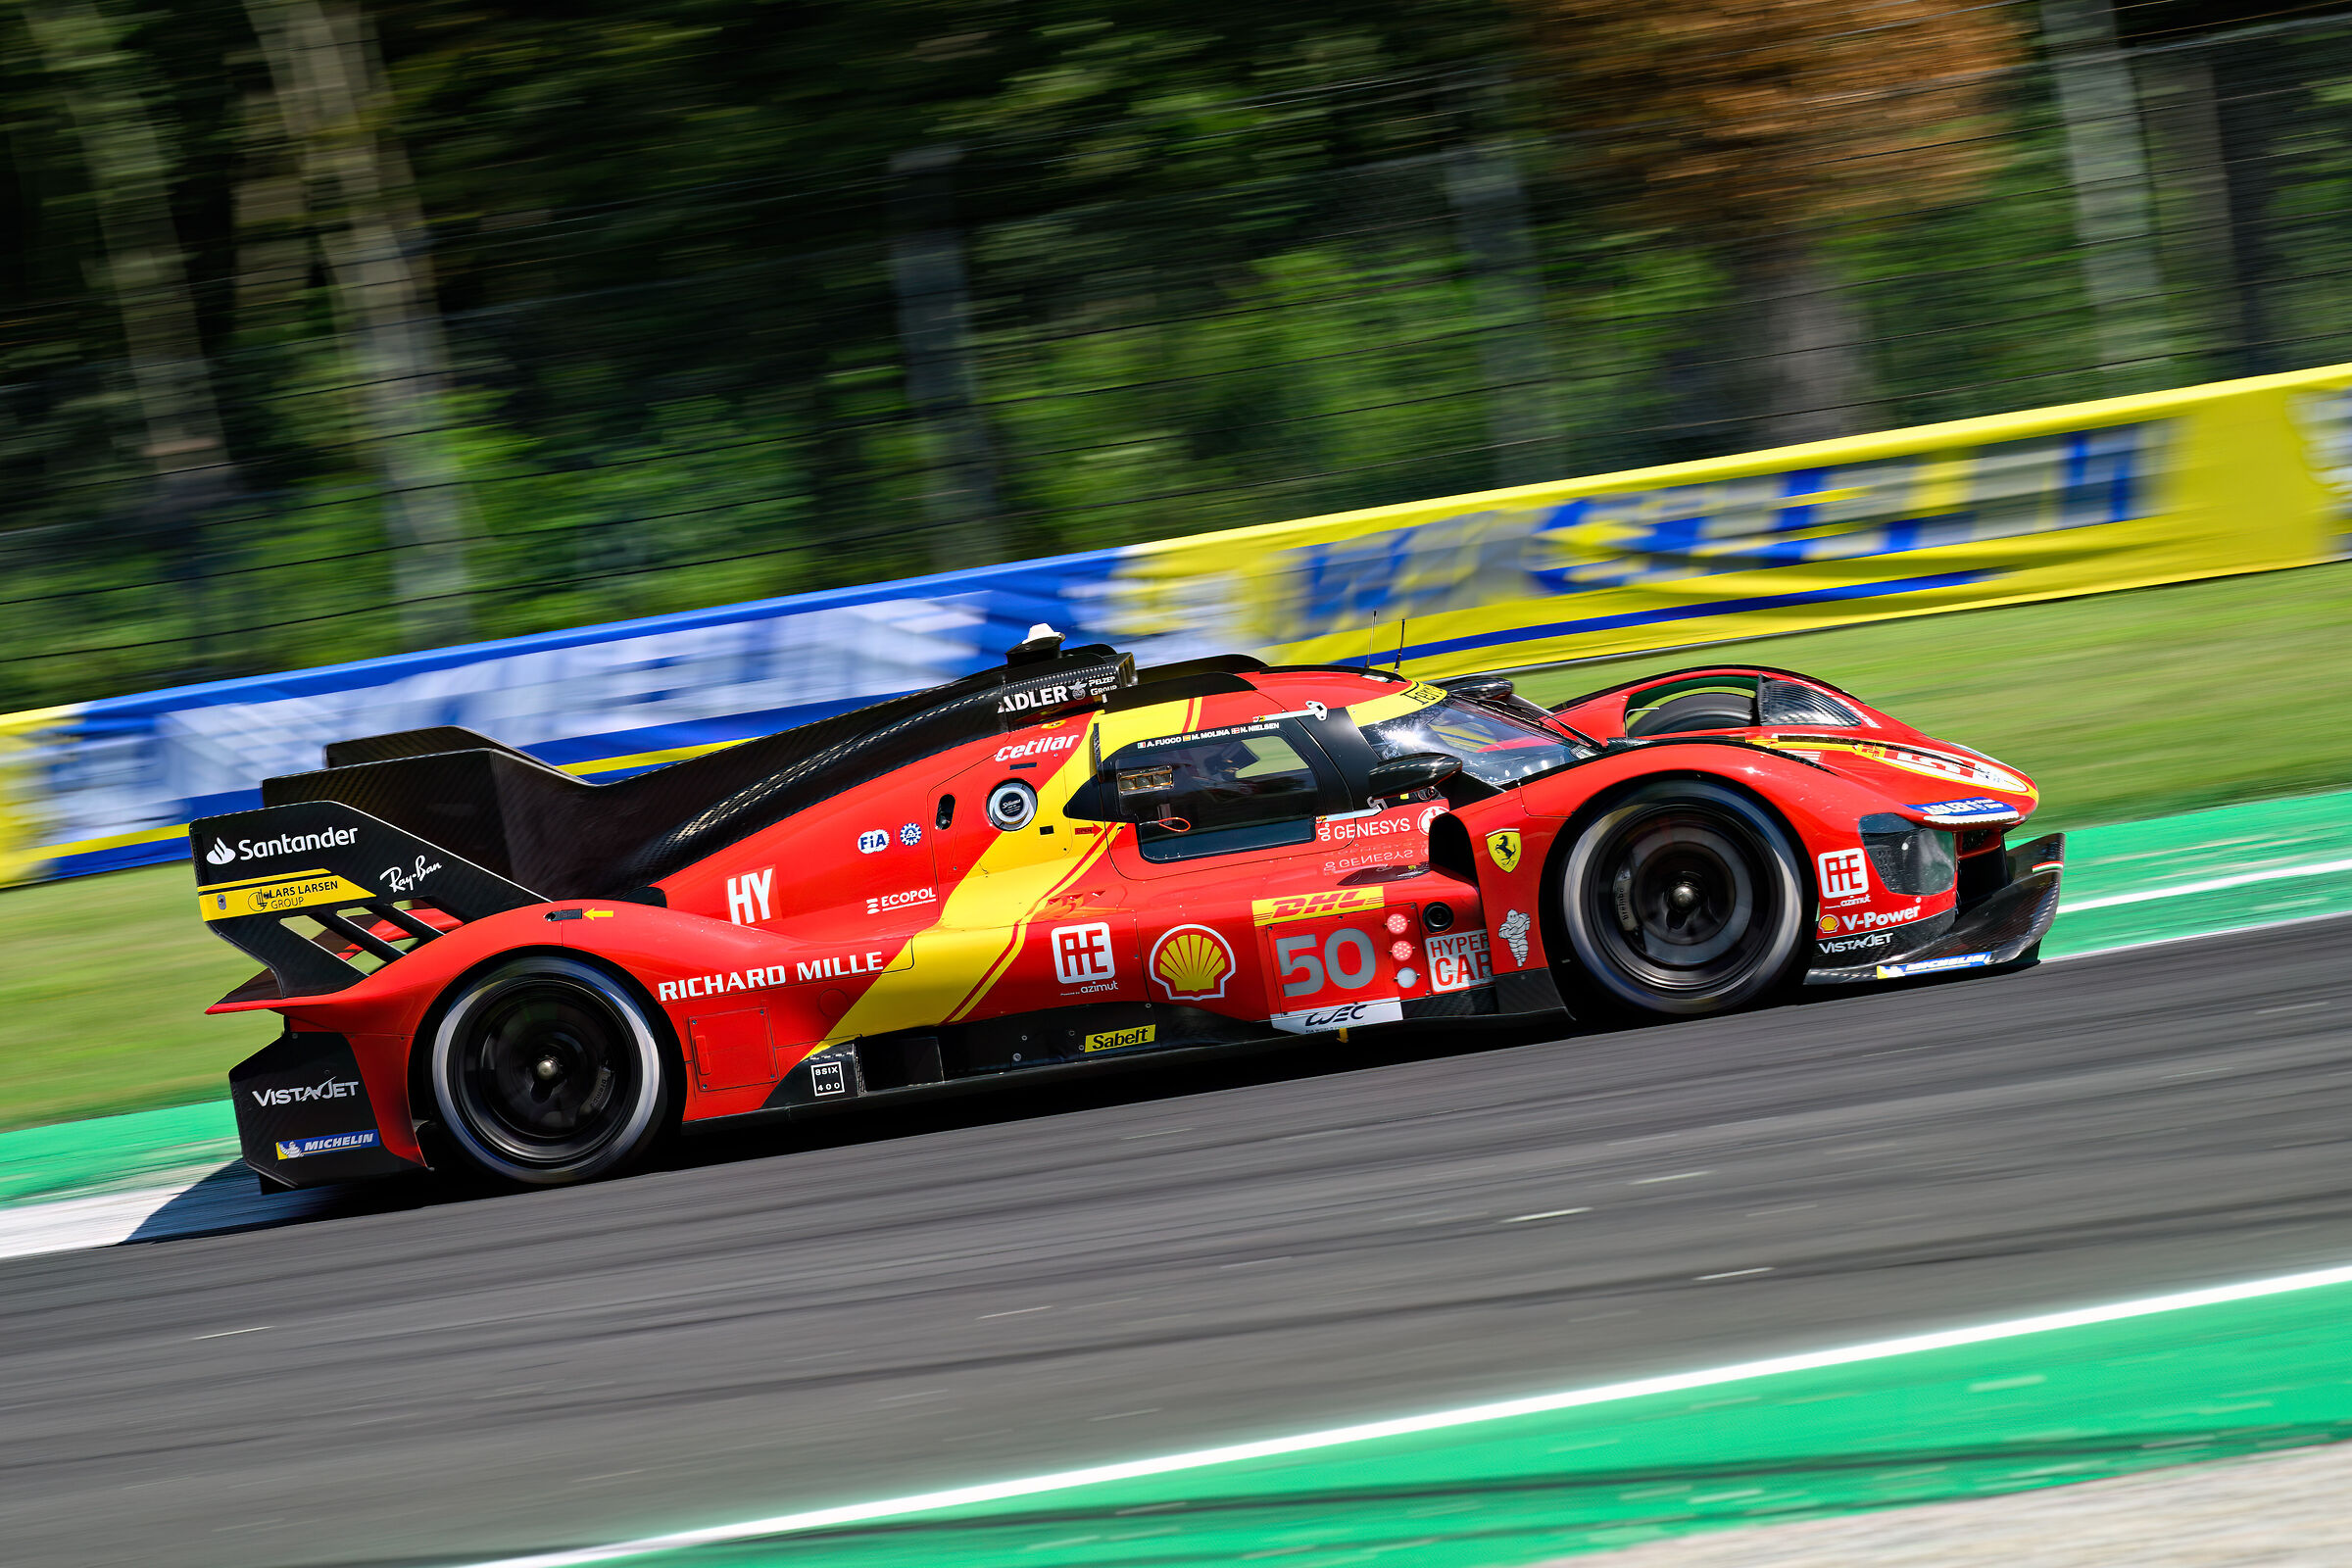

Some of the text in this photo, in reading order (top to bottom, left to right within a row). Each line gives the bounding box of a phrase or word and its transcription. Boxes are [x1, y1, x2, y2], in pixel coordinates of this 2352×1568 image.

[998, 685, 1068, 713] ADLER
[1156, 735, 1182, 748] FUOCO
[1200, 728, 1231, 740] MOLINA
[1249, 722, 1280, 732] NIELSEN
[1334, 817, 1411, 840] GENESYS
[238, 826, 359, 860] Santander
[379, 855, 442, 894] Ray-Ban
[270, 880, 338, 899] LARS LARSEN
[727, 867, 772, 926] HY
[881, 886, 936, 907] ECOPOL
[1840, 894, 1871, 907] azimut
[270, 896, 304, 909] GROUP
[1272, 891, 1365, 918] DHL
[1841, 905, 1921, 931] V-Power
[1430, 933, 1492, 958] HYPER
[1275, 927, 1377, 998] 50
[1435, 951, 1494, 986] CAR
[658, 951, 884, 1002] RICHARD MILLE
[1080, 980, 1119, 994] azimut
[1304, 1004, 1368, 1026] WEC
[1092, 1028, 1149, 1050] Sabelt
[814, 1066, 839, 1076] 8SIX
[817, 1082, 841, 1092] 400
[304, 1133, 374, 1152] MICHELIN
